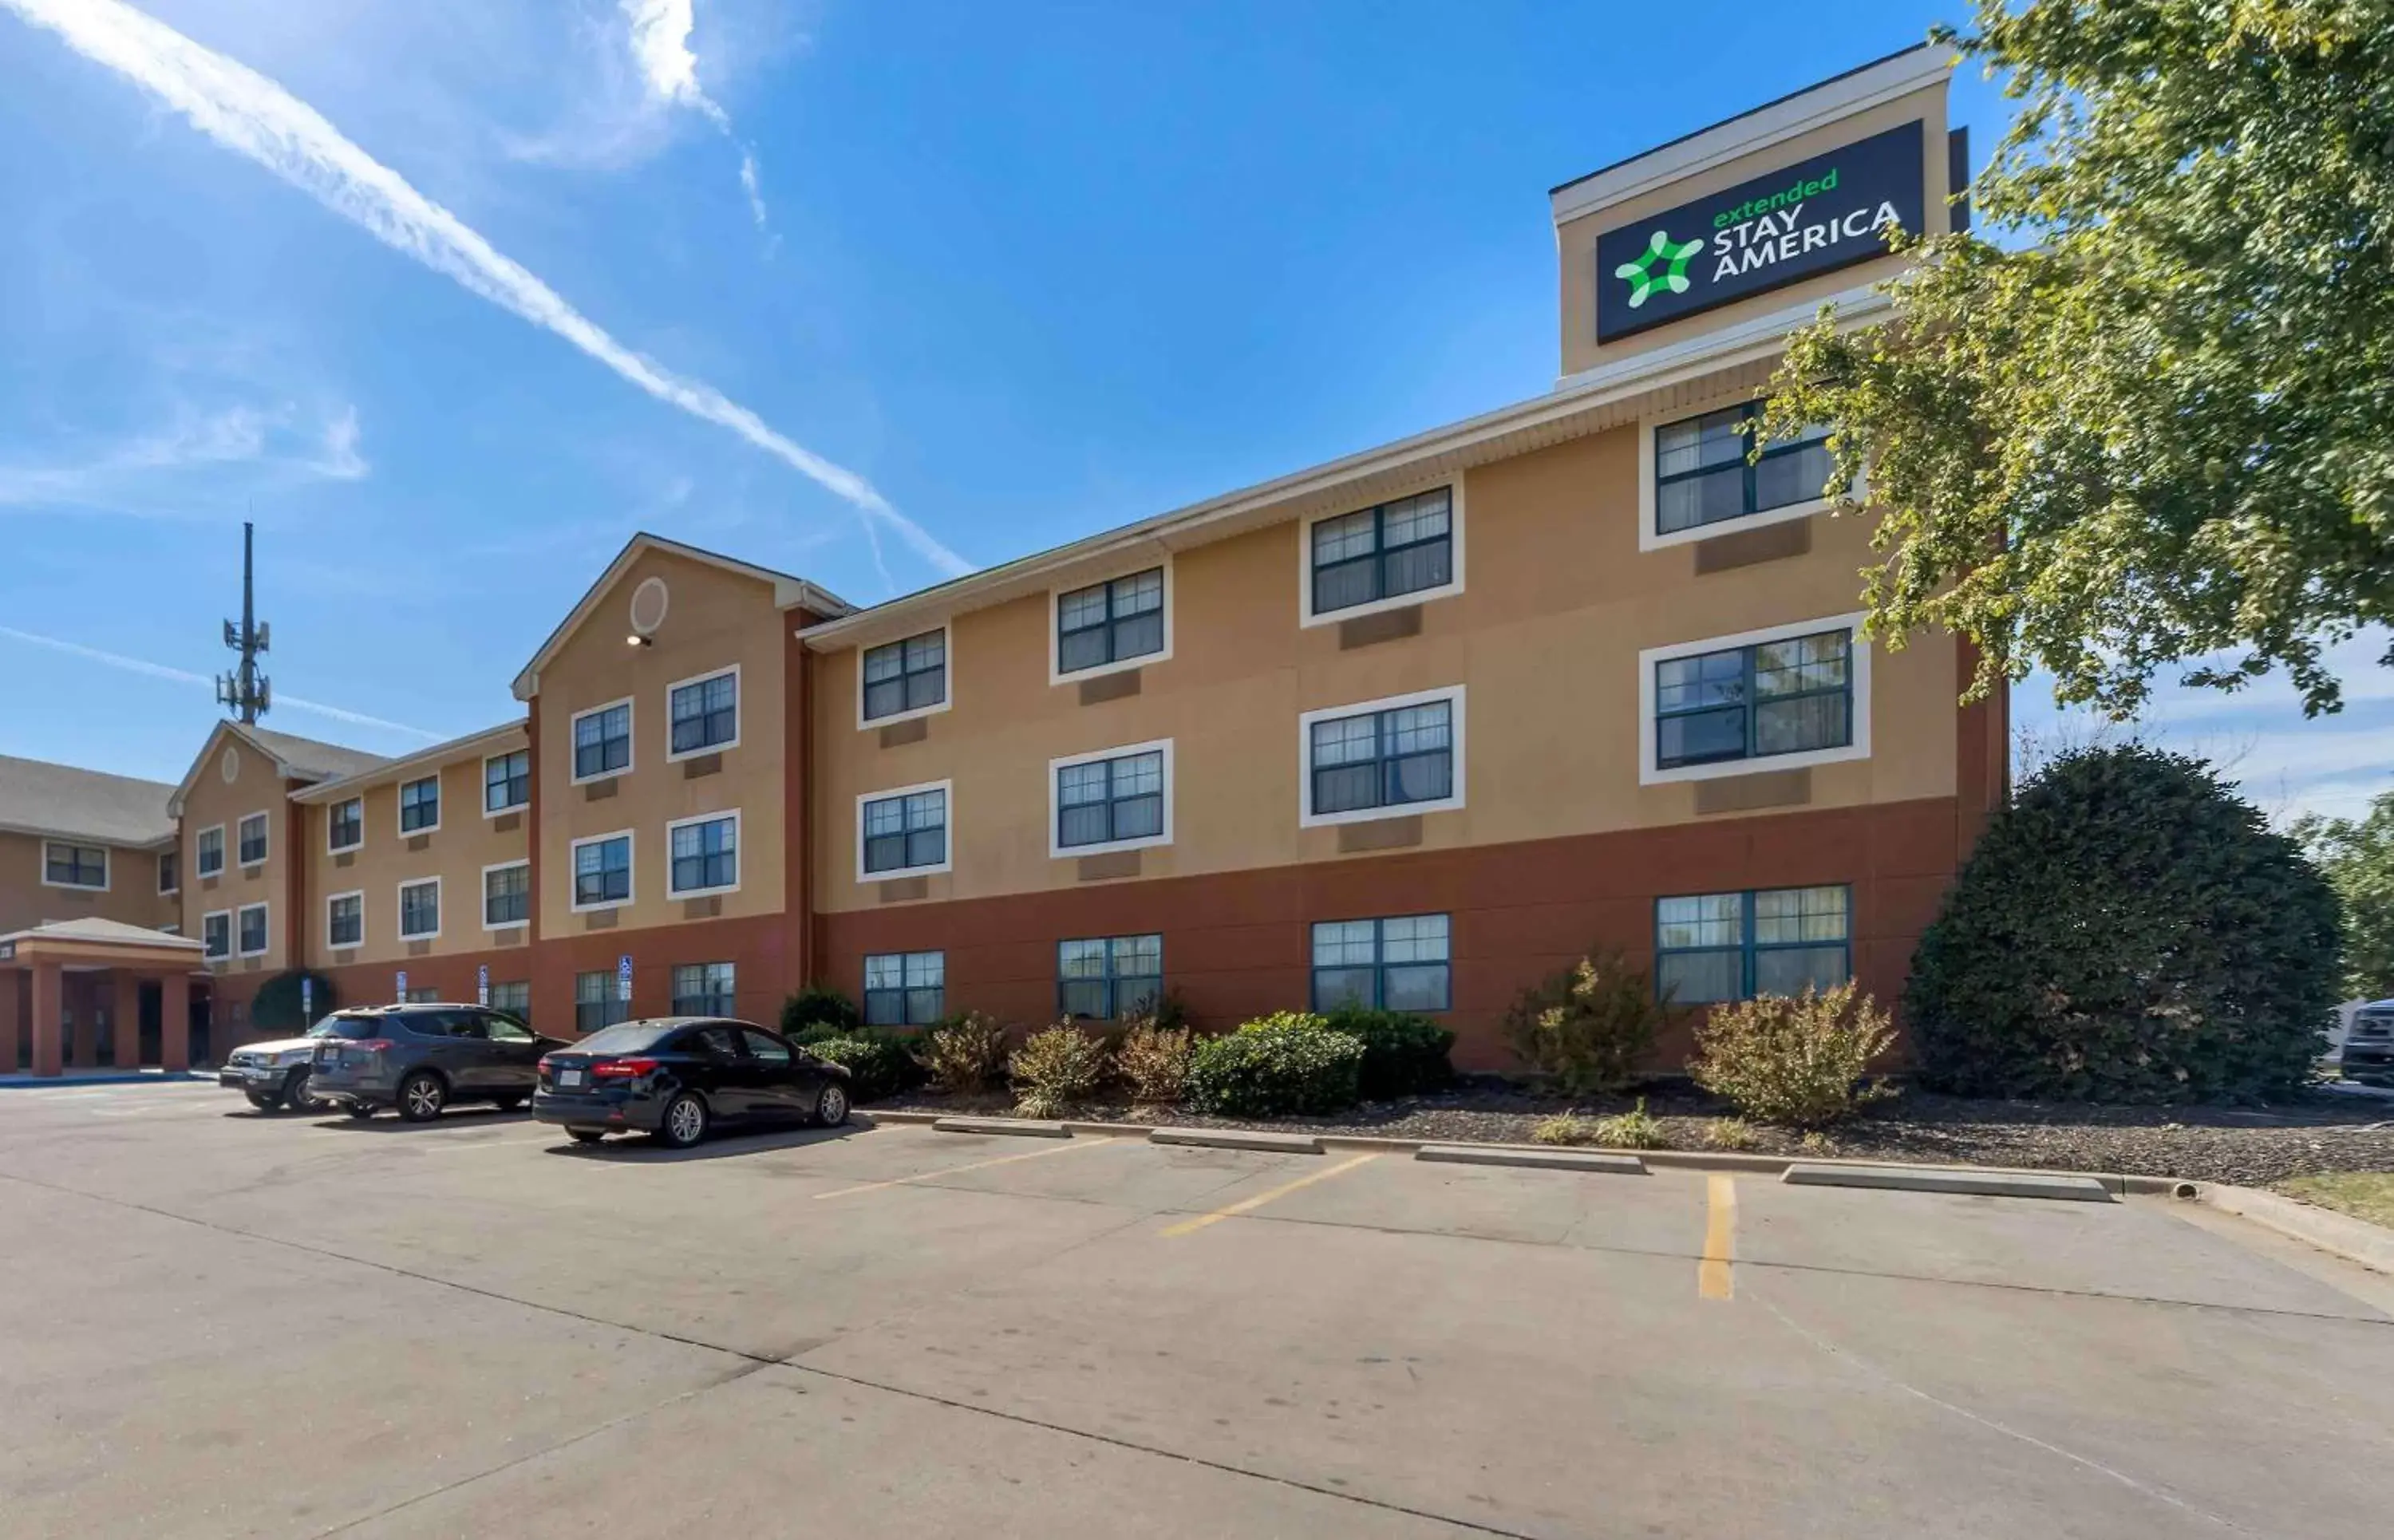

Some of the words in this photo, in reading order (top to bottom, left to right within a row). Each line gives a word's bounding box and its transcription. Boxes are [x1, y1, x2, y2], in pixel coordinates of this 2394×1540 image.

[1713, 168, 1837, 228] extended
[1713, 203, 1803, 256] STAY
[1713, 200, 1901, 282] AMERICA
